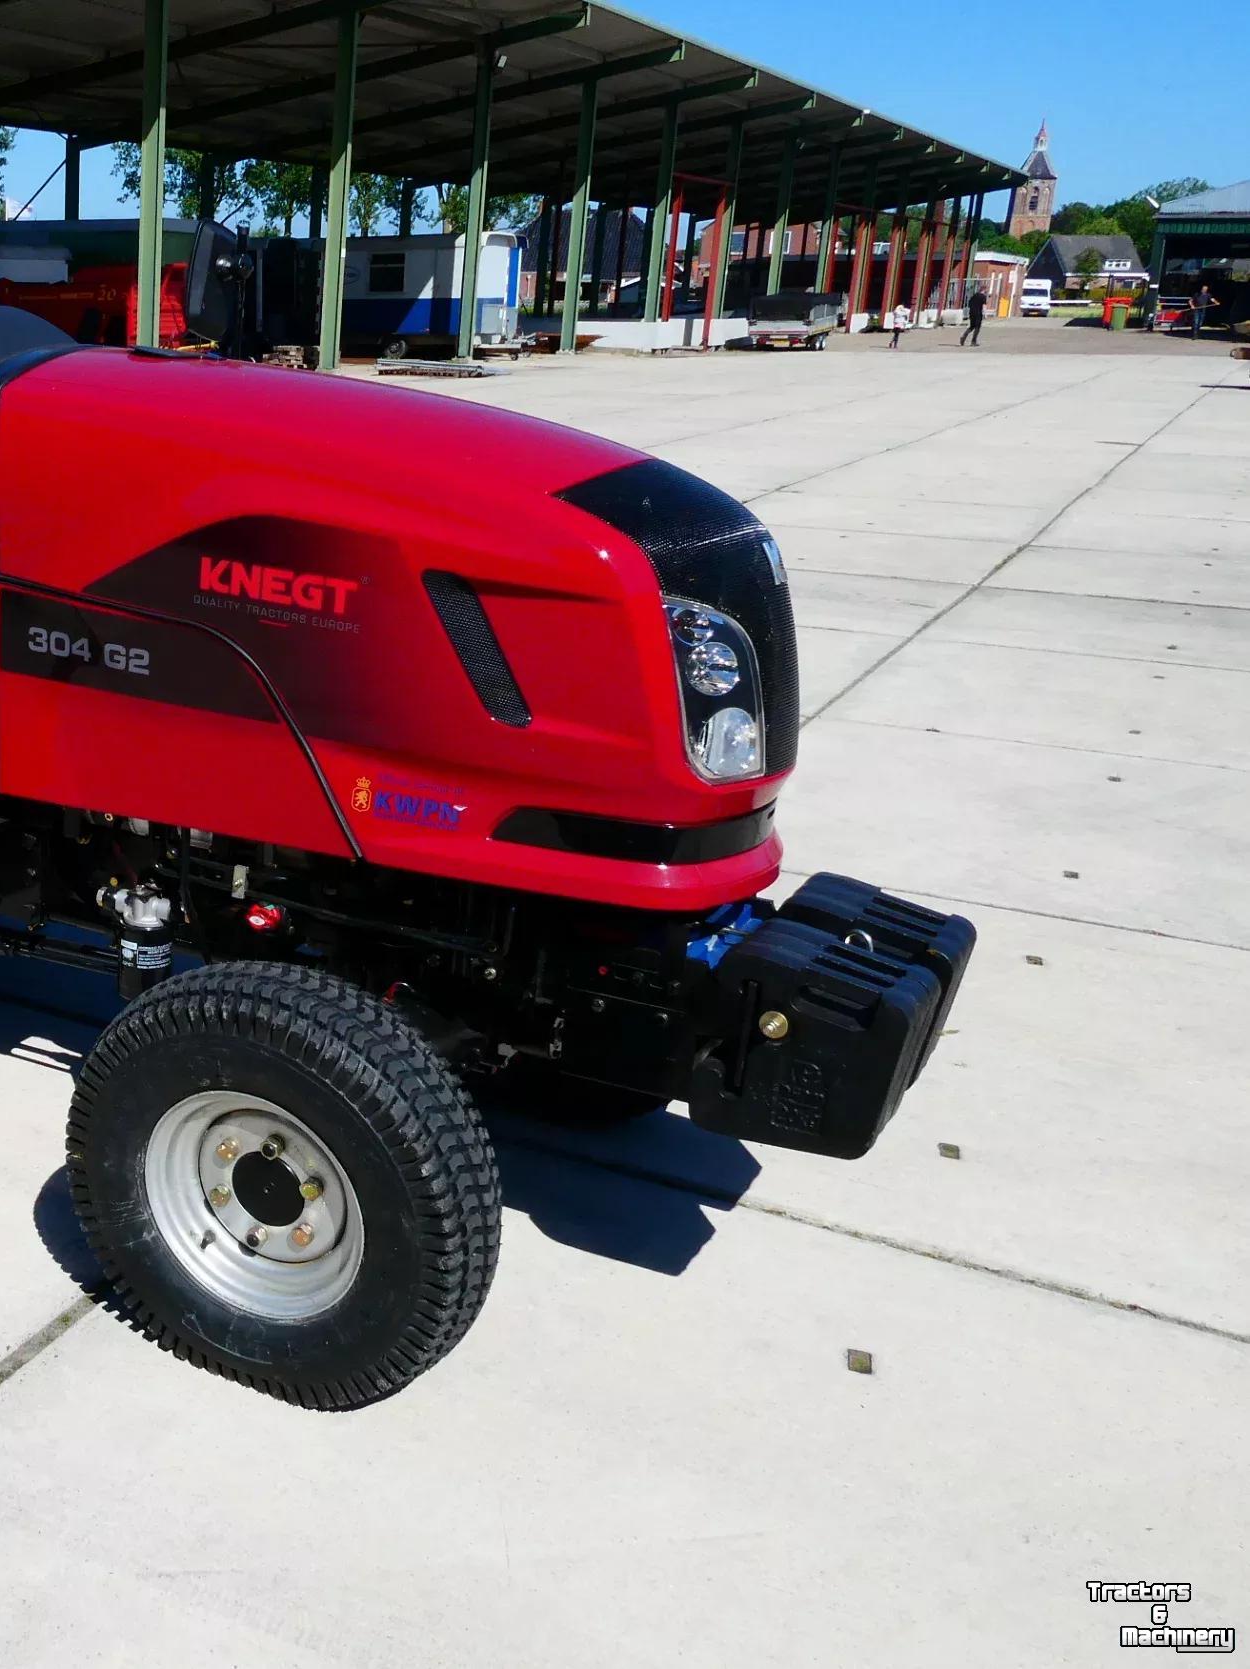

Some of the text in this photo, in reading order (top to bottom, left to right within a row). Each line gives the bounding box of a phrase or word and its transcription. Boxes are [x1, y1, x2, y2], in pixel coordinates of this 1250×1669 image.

[200, 556, 358, 614] KNEGT
[193, 594, 362, 634] QUALITY TRACTORS EUROPE
[28, 626, 150, 675] 304 G2
[374, 790, 462, 823] KWPN
